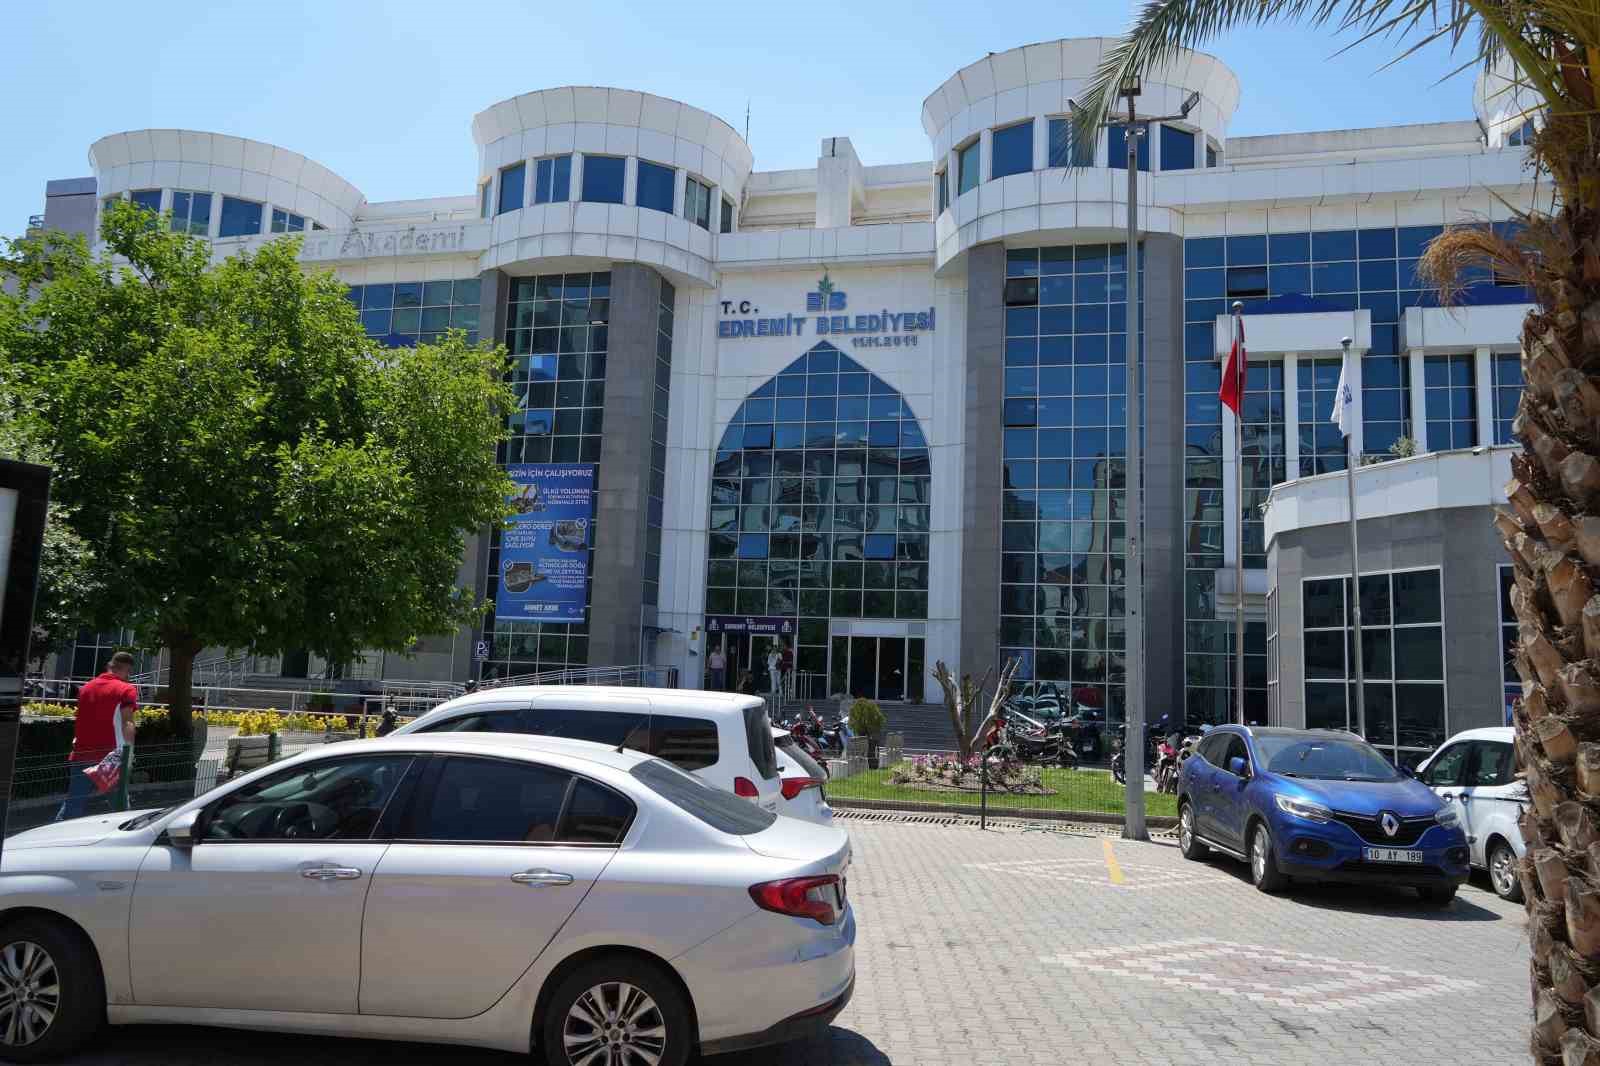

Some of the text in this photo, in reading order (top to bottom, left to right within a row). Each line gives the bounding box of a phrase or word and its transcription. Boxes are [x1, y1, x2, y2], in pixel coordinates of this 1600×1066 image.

[340, 226, 465, 257] Akademi
[721, 301, 759, 314] T.C.
[718, 307, 936, 337] EDREMİT BELEDİYESİ
[1369, 850, 1422, 862] 10 AY 189
